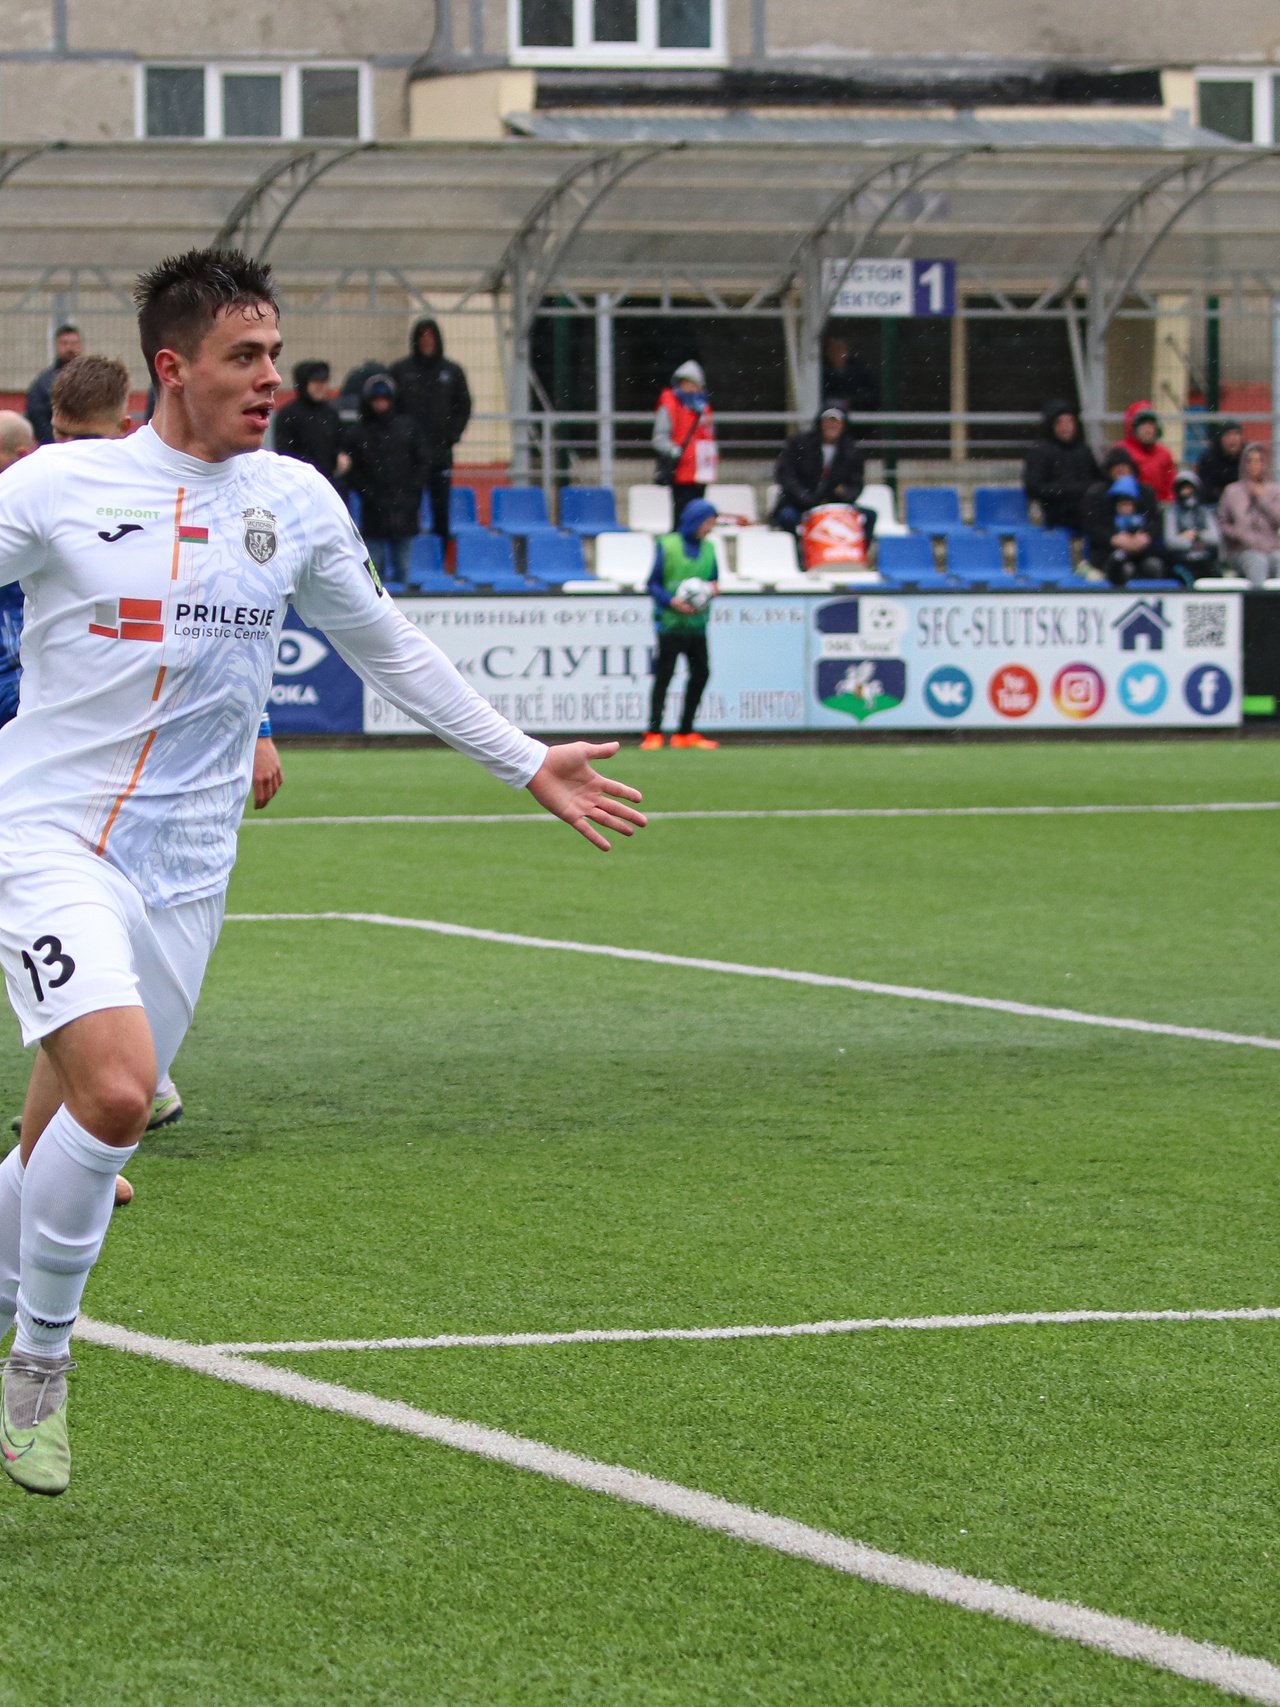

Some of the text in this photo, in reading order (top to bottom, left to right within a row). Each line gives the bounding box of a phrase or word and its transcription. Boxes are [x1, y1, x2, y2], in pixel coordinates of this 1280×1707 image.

[919, 261, 945, 314] 1
[96, 507, 160, 520] евроопт
[176, 603, 275, 626] PRILESIE
[406, 607, 545, 625] ОРТИВНЫЙ
[917, 606, 1106, 647] SFC-SLUTSK.BY
[174, 624, 269, 640] Logistic Center
[455, 645, 658, 683] «СЛУЦ
[21, 935, 75, 1002] 13
